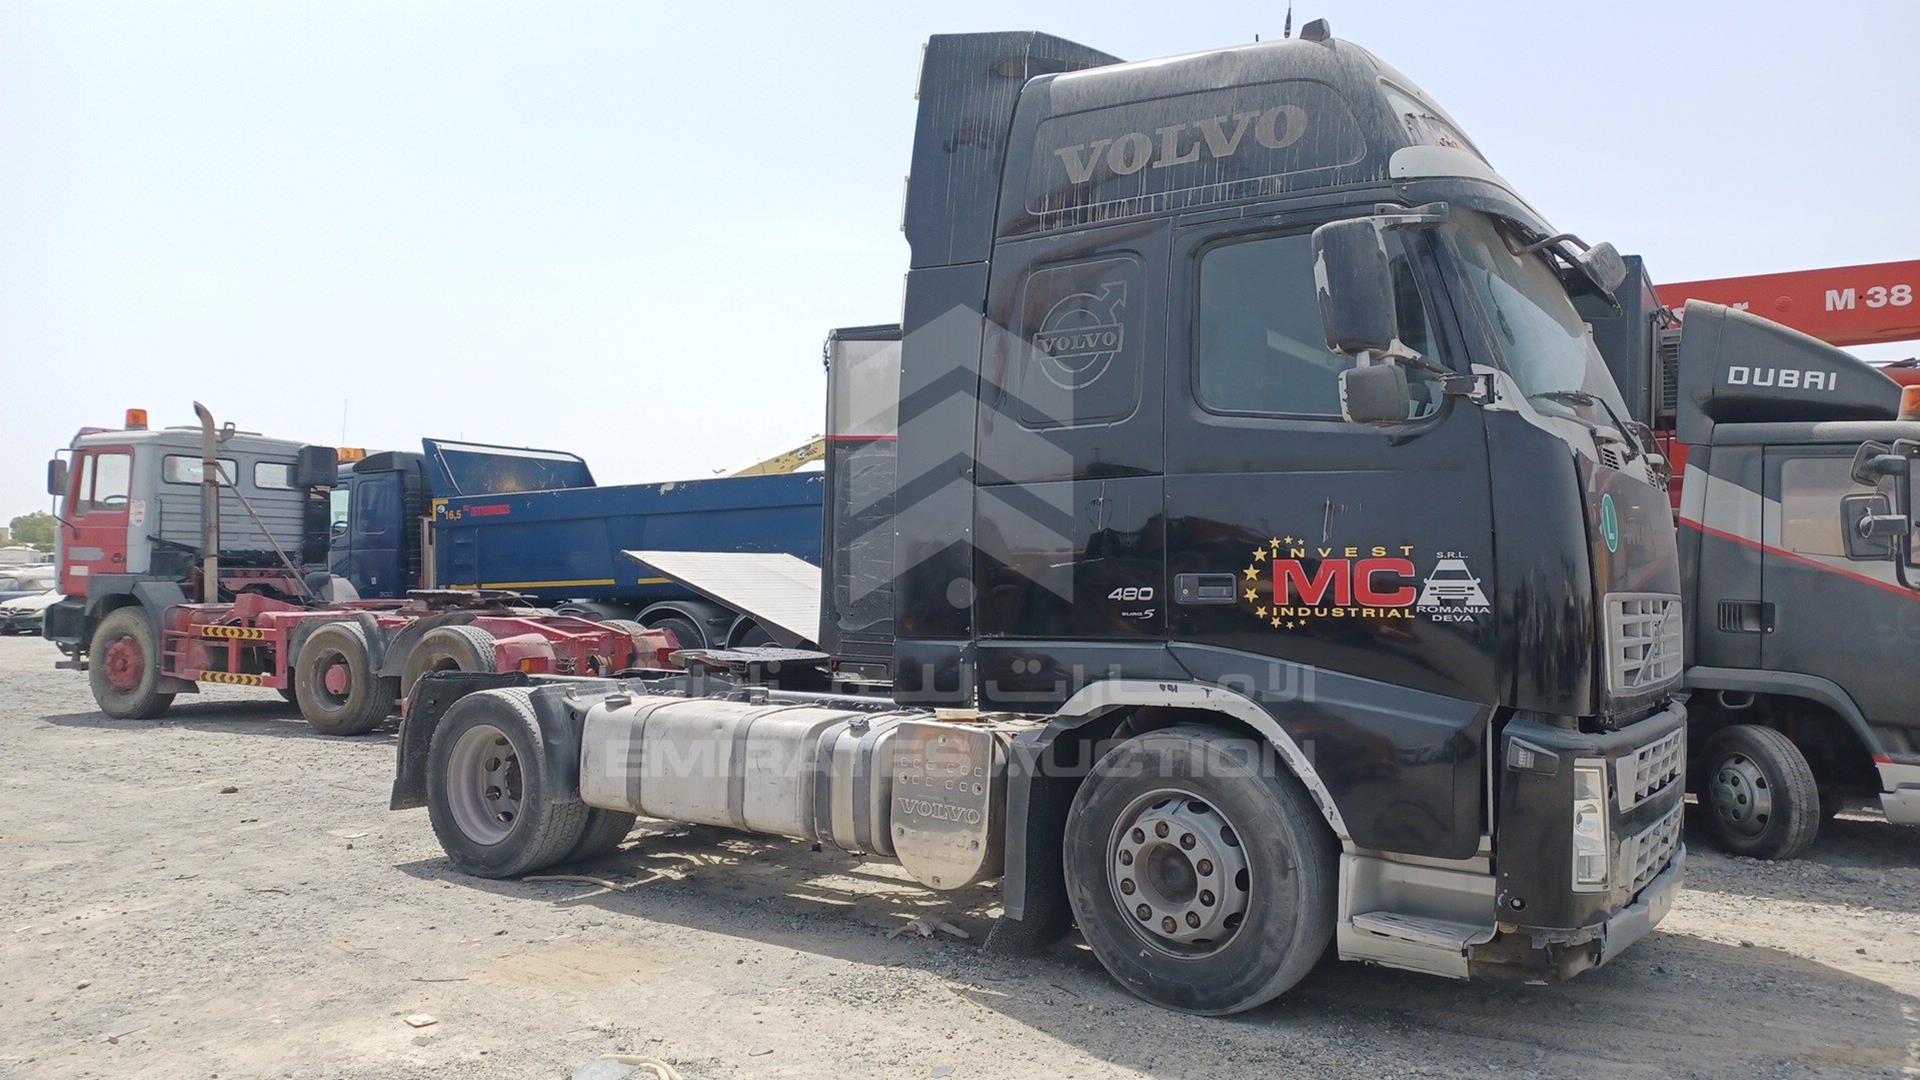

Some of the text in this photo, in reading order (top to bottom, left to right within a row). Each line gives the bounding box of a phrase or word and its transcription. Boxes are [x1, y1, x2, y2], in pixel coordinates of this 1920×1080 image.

[1054, 104, 1308, 184] VOLVO
[1866, 284, 1913, 308] 38
[1039, 331, 1117, 352] VOLVO
[1728, 366, 1837, 391] DUBAI
[1272, 545, 1414, 558] INVEST
[1436, 551, 1469, 560] S.R.L.
[1108, 587, 1154, 601] 480
[1272, 607, 1416, 619] INDUSTRIAL
[1416, 605, 1491, 614] ROMANIA
[1432, 615, 1474, 623] DEVA
[898, 797, 981, 824] VOLVO
